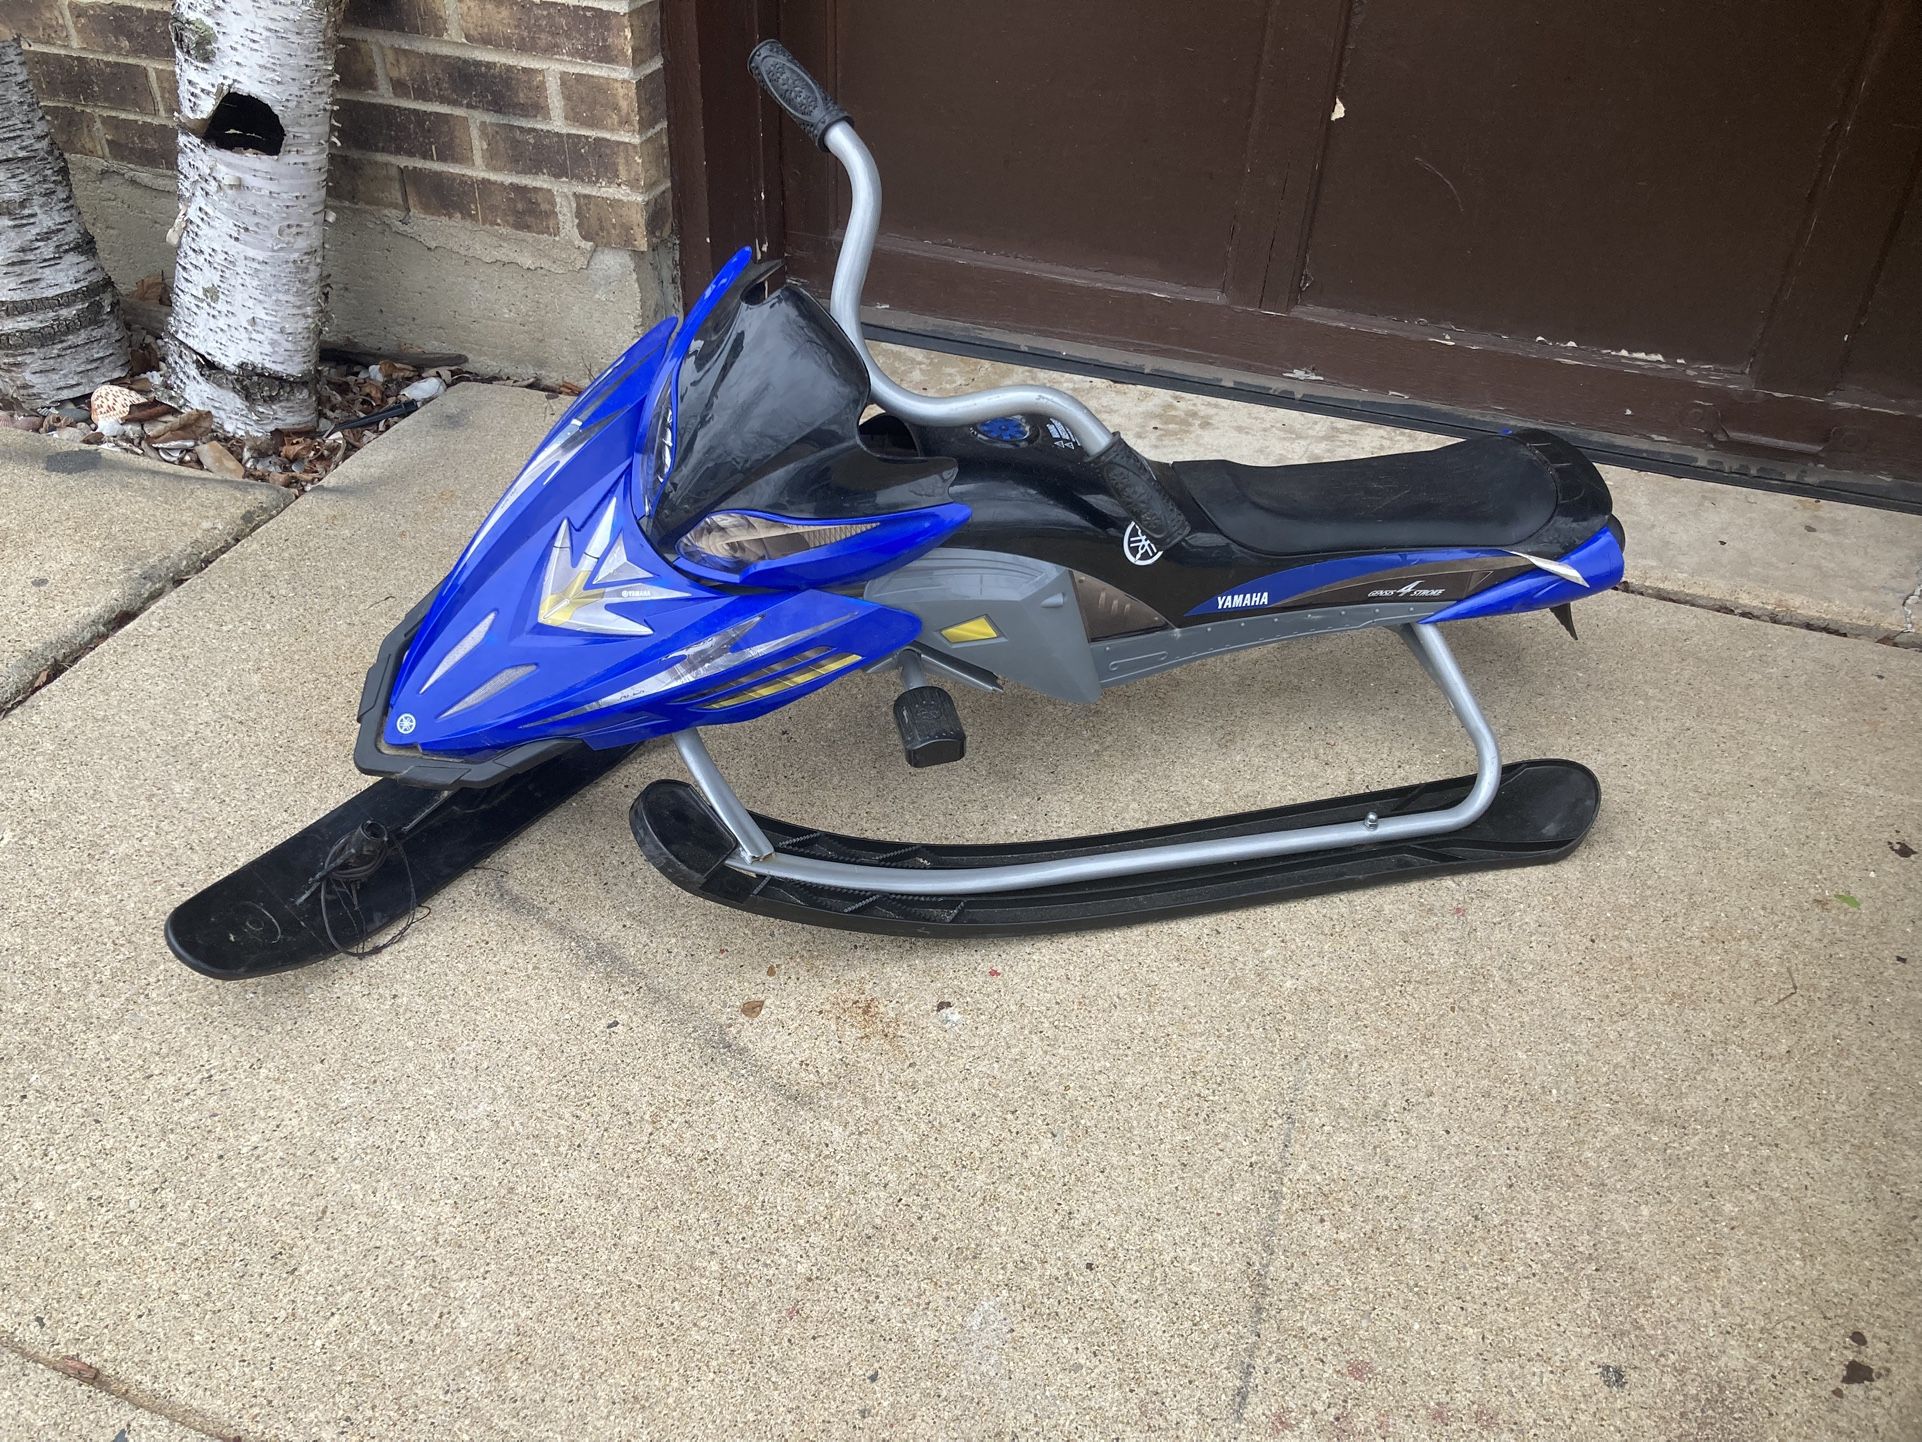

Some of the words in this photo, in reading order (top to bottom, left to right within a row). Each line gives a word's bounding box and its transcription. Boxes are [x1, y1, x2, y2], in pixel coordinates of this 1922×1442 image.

[1396, 580, 1425, 597] 4
[1409, 588, 1446, 597] STROKE
[1217, 591, 1269, 609] YAMAHA
